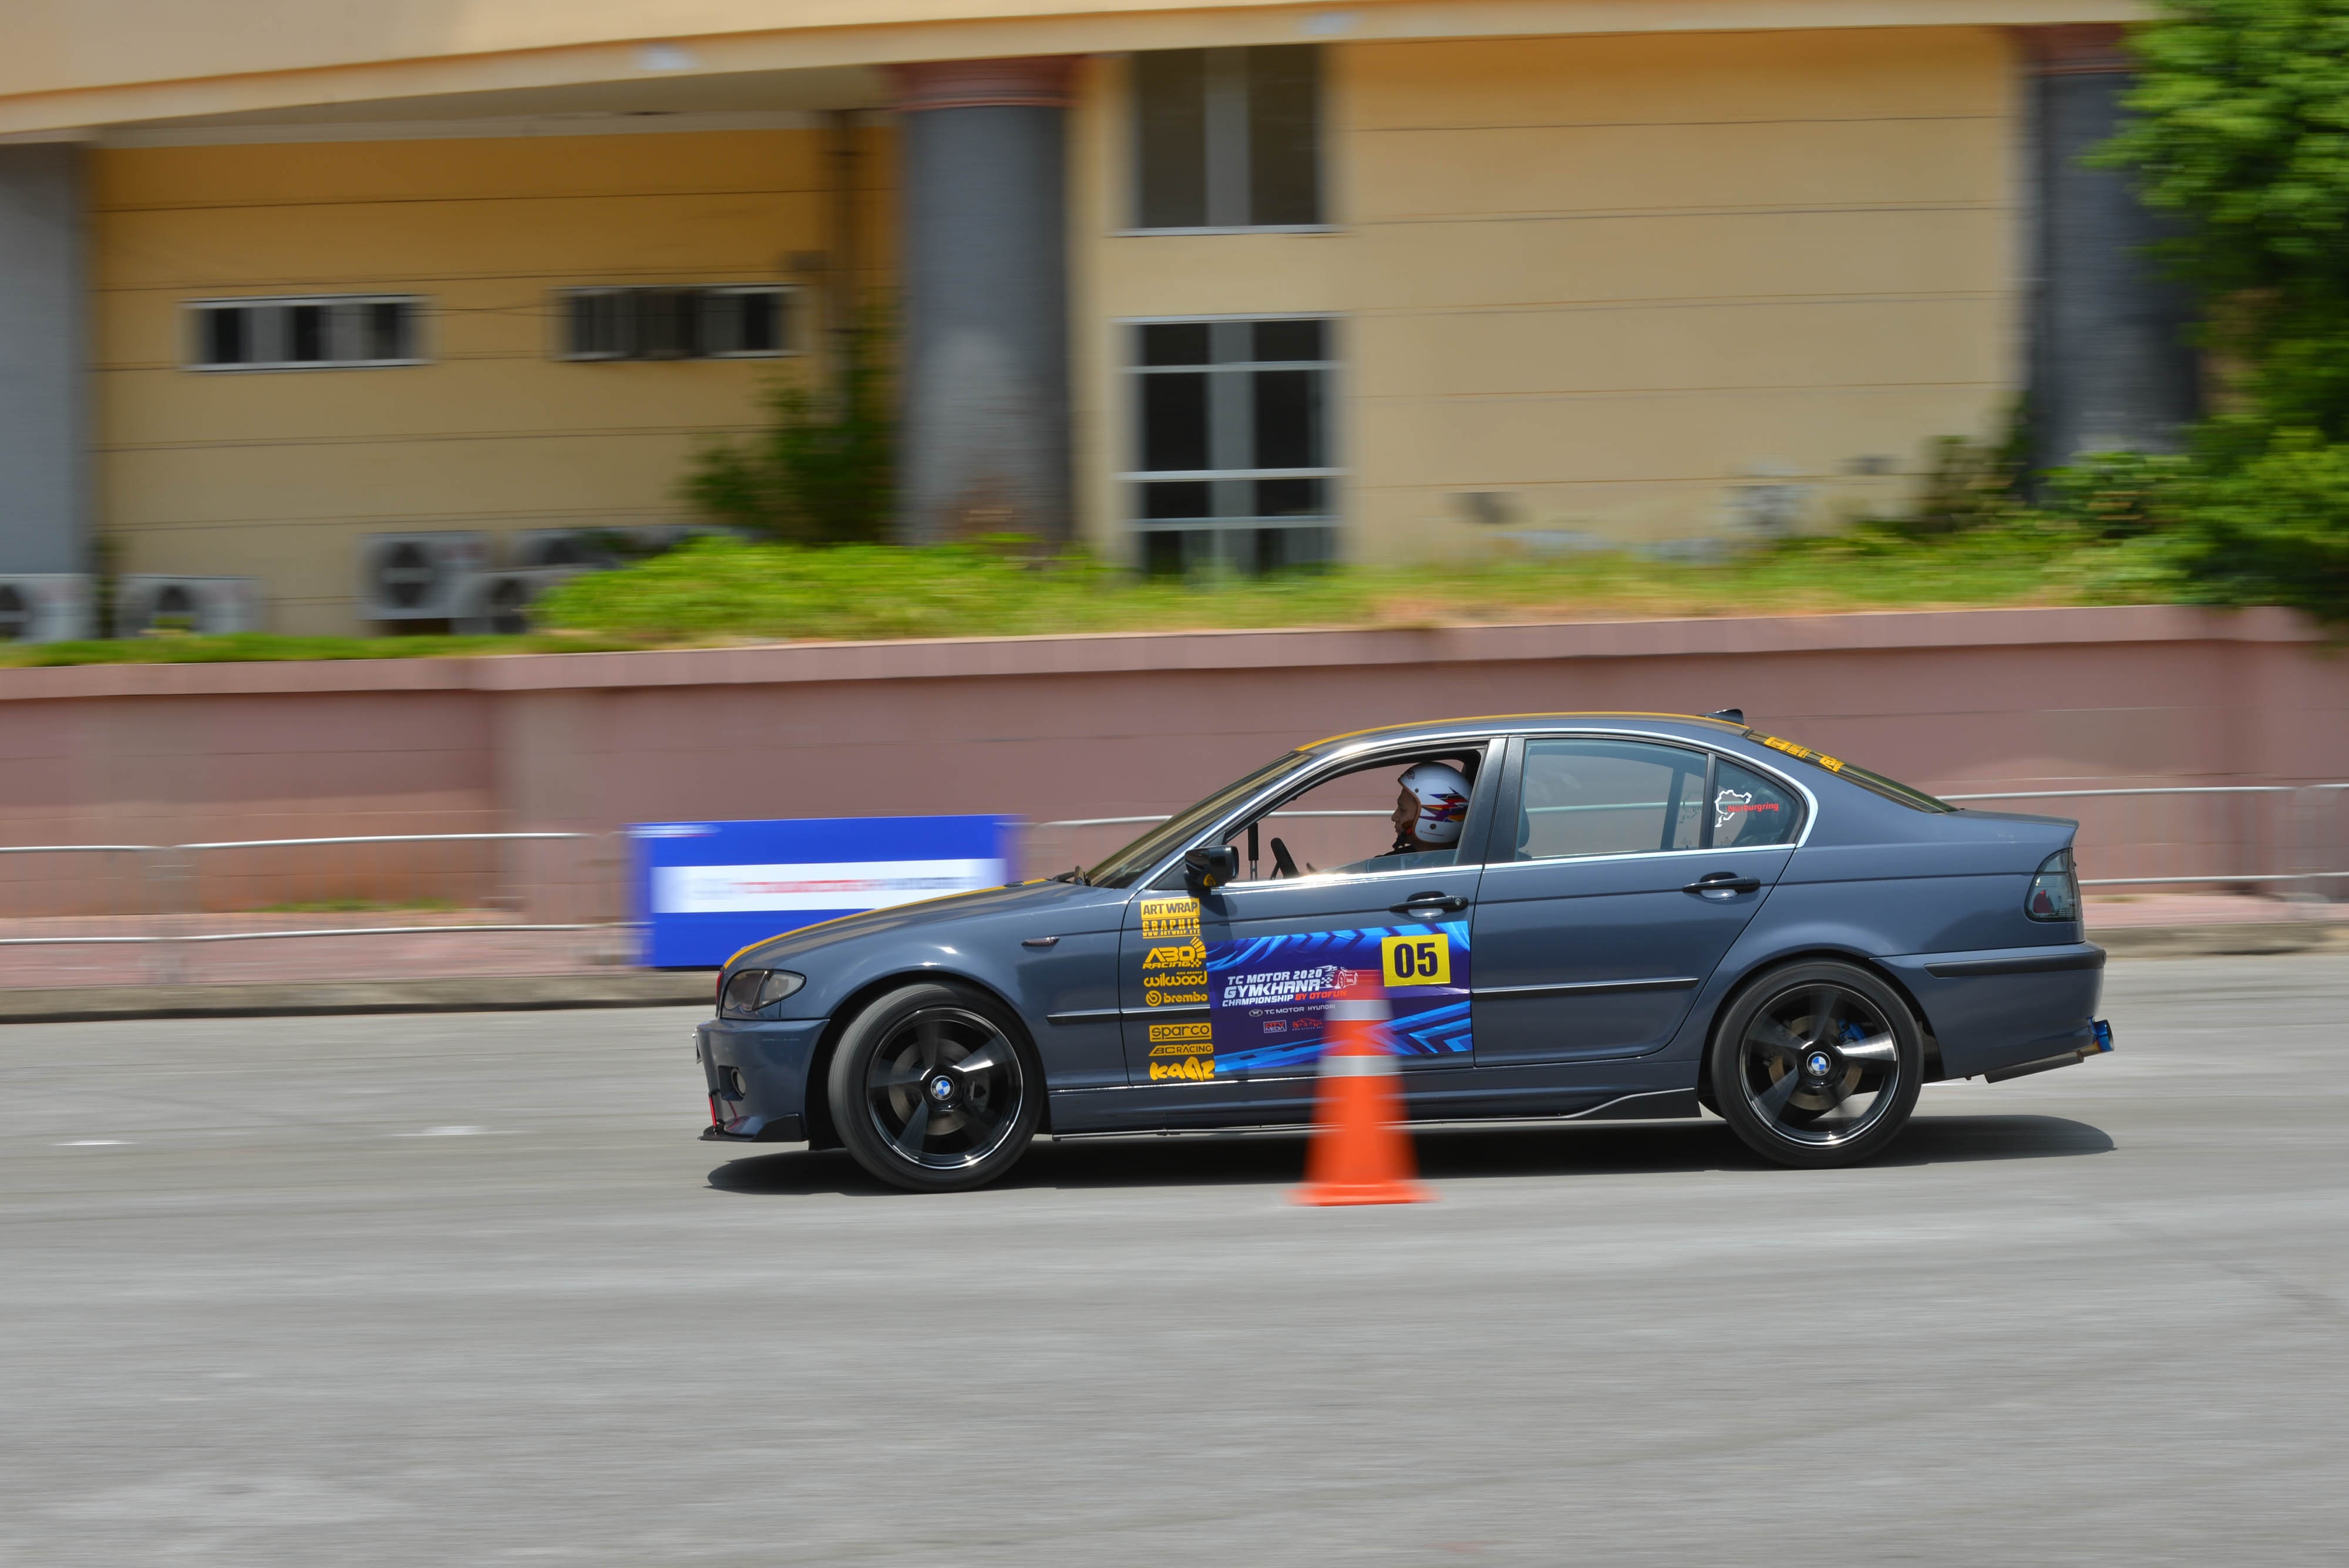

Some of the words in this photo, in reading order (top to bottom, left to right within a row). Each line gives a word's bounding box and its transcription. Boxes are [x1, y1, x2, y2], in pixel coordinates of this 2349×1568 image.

[1727, 803, 1779, 812] Nürburgring
[1143, 904, 1164, 915] ART
[1166, 901, 1198, 914] WRAP
[1142, 918, 1200, 931] GRAPHIC
[1142, 961, 1191, 970] RACING
[1394, 942, 1438, 978] 05
[1143, 971, 1207, 987] wilwood
[1227, 975, 1244, 985] TC
[1246, 971, 1290, 984] MOTOR
[1293, 969, 1322, 980] 2020
[1224, 978, 1321, 999] GYMKHANA
[1163, 991, 1208, 1004] brembo
[1222, 994, 1294, 1007] CHAMPIONSHIP
[1309, 990, 1347, 1000] OTOFUN
[1152, 1025, 1210, 1040] sparco
